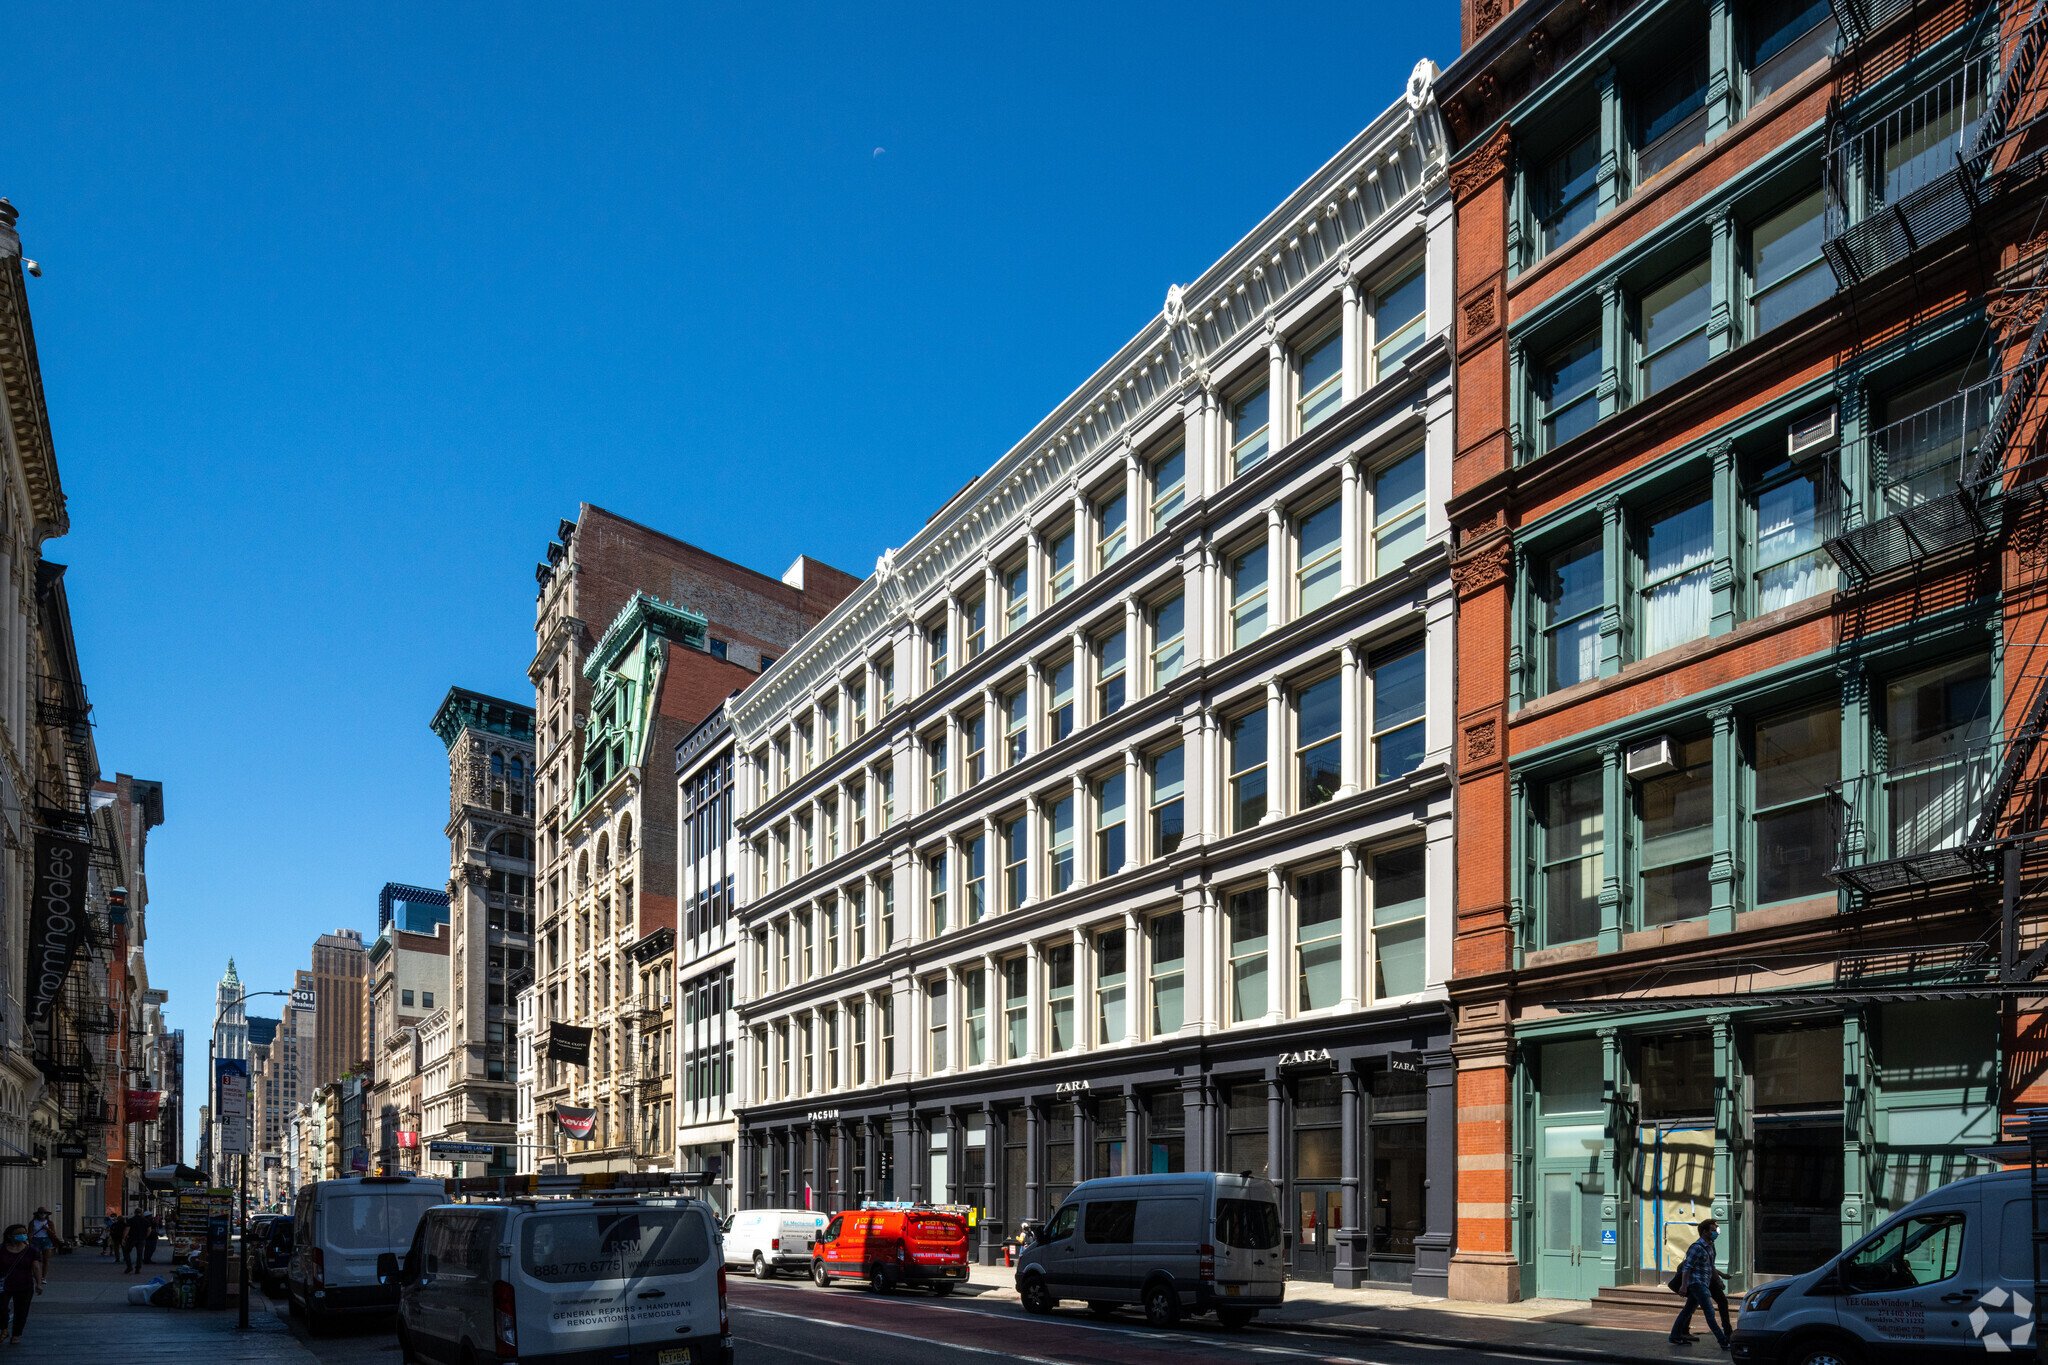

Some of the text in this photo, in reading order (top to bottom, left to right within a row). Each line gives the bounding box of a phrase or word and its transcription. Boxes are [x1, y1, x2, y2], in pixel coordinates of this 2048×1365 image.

[292, 992, 314, 1001] 401
[292, 1000, 315, 1010] Broadway
[1278, 1048, 1332, 1065] ZARA
[1392, 1060, 1416, 1072] ZARA
[224, 1076, 230, 1085] 3
[1055, 1080, 1090, 1093] ZARA
[224, 1116, 229, 1125] 2
[807, 1109, 839, 1121] PACSUN
[611, 1239, 641, 1252] RSM
[534, 1260, 621, 1277] 888.776.6775
[628, 1257, 699, 1270] WWW.RSM365.COM
[1845, 1297, 1859, 1306] YEE
[1861, 1297, 1879, 1307] Glass
[1880, 1298, 1909, 1308] Window
[553, 1301, 691, 1320] GENERAL REPAIRS HANDYMAN
[1906, 1310, 1925, 1318] Street
[567, 1315, 628, 1327] RENOVATIONS
[638, 1310, 681, 1319] REMODELS
